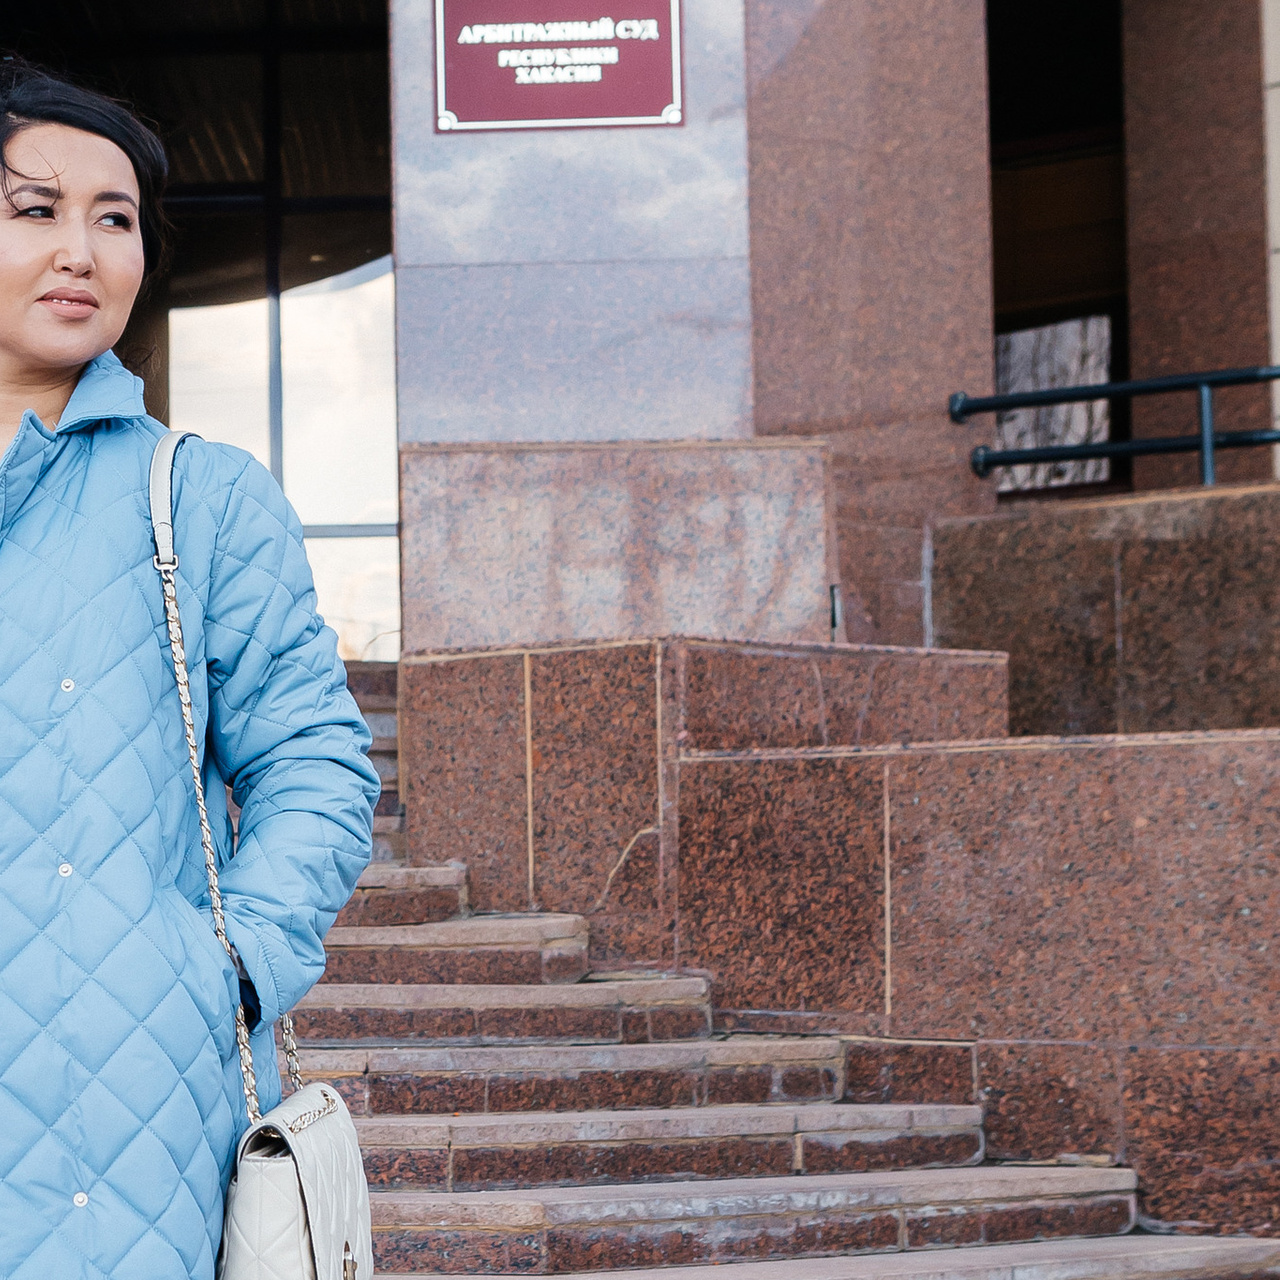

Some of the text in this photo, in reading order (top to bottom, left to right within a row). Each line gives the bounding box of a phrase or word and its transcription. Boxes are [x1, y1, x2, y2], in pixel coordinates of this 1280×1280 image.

[457, 17, 660, 44] АРБИТРАЖНЫЙ СУД
[498, 46, 619, 67] РЕСПУБЛИКИ
